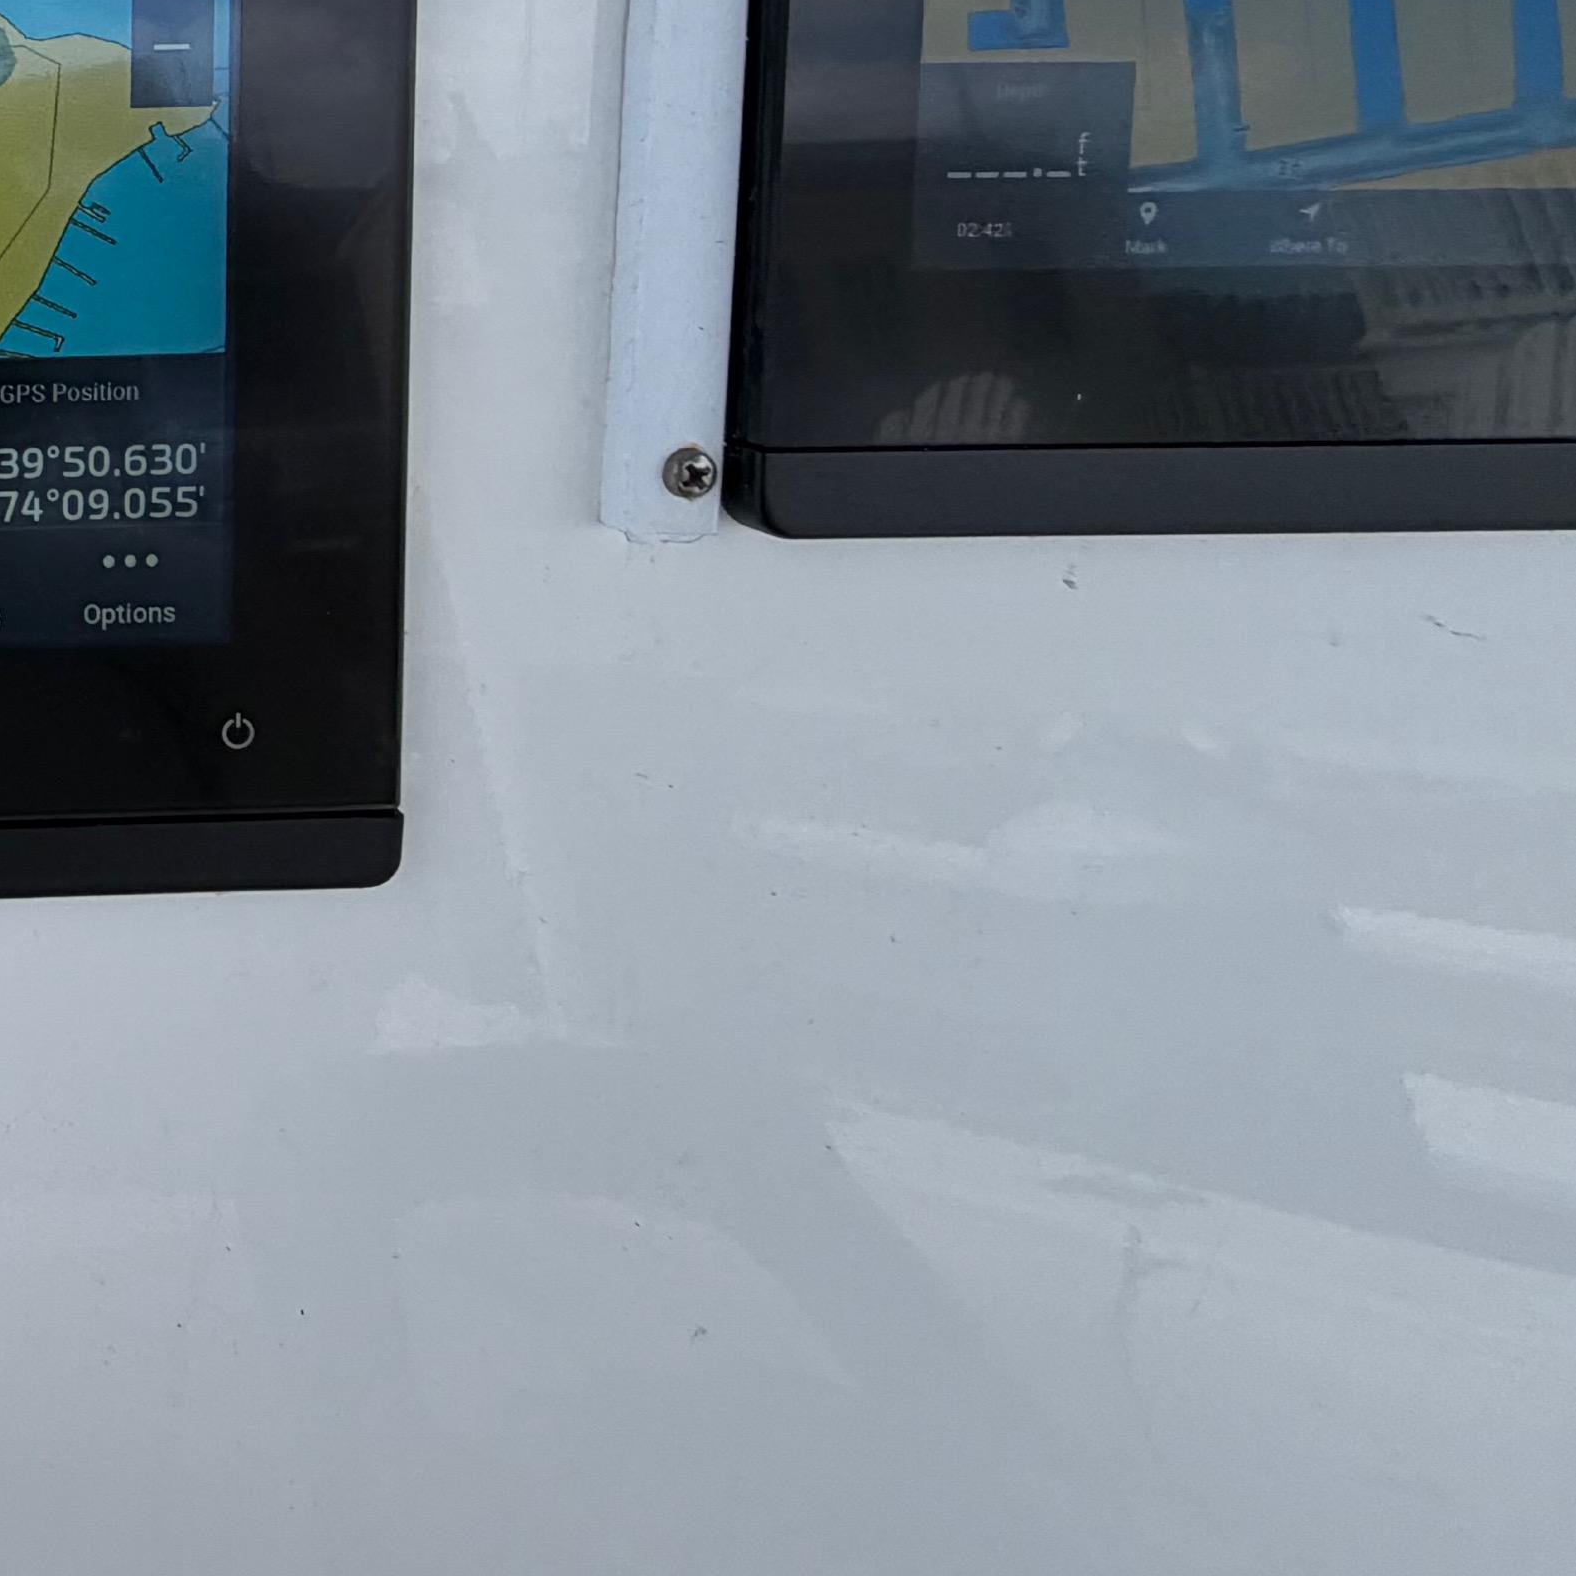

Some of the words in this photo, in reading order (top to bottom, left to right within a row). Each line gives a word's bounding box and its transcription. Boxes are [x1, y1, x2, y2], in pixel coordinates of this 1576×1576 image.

[0, 383, 47, 405] GPS
[52, 381, 141, 403] Position
[83, 603, 177, 630] Options
